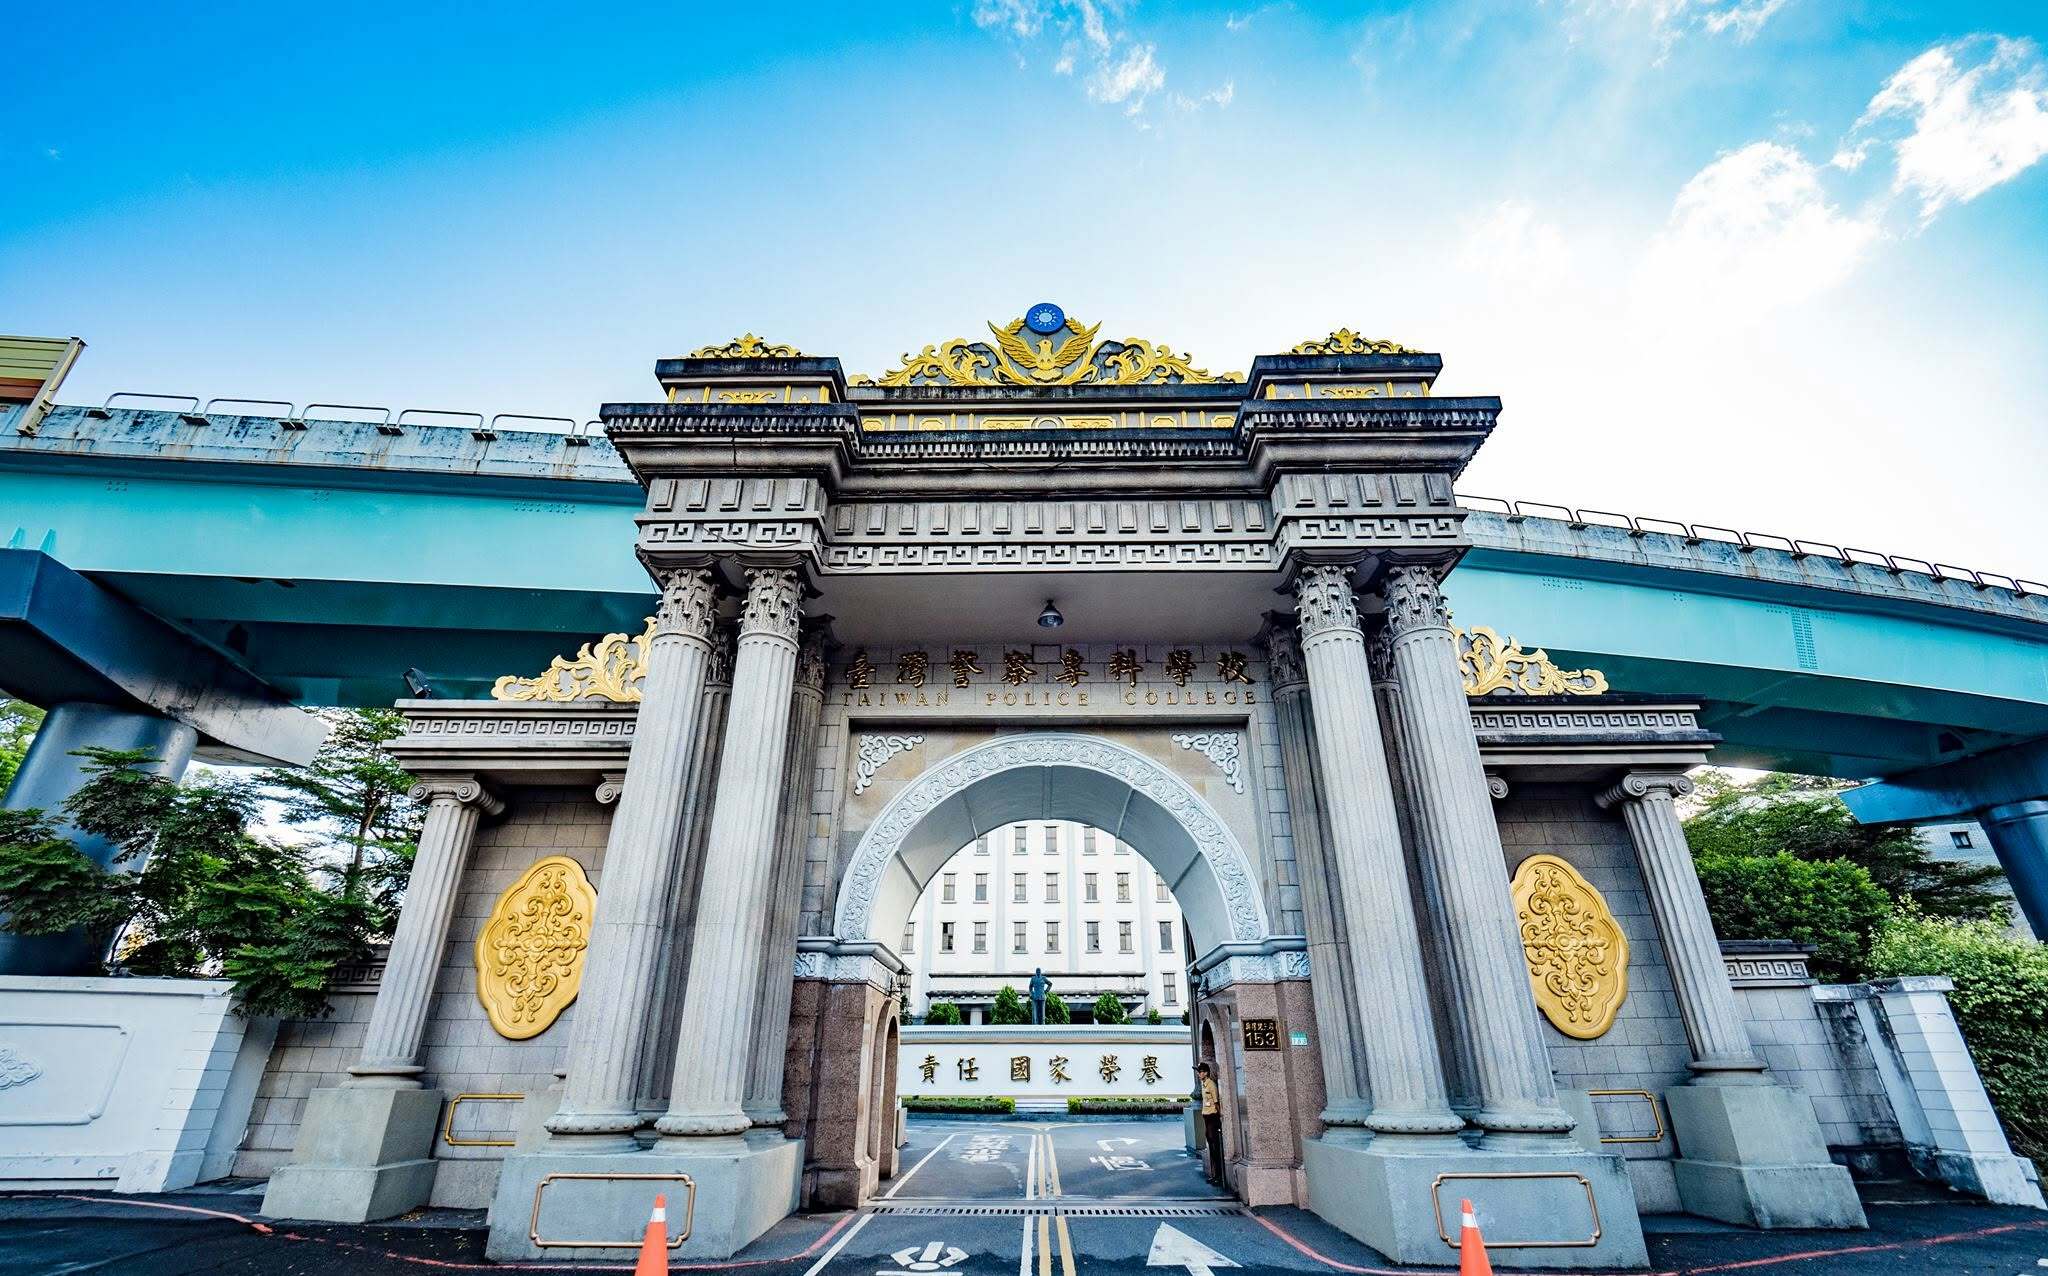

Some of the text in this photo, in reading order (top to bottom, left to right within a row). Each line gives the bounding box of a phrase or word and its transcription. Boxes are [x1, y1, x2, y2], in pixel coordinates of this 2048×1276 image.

[841, 691, 1257, 706] TAIWAN POLICE COLLEGE
[1245, 1032, 1276, 1047] 153
[918, 1053, 1163, 1085] 責任 國家 榮譽
